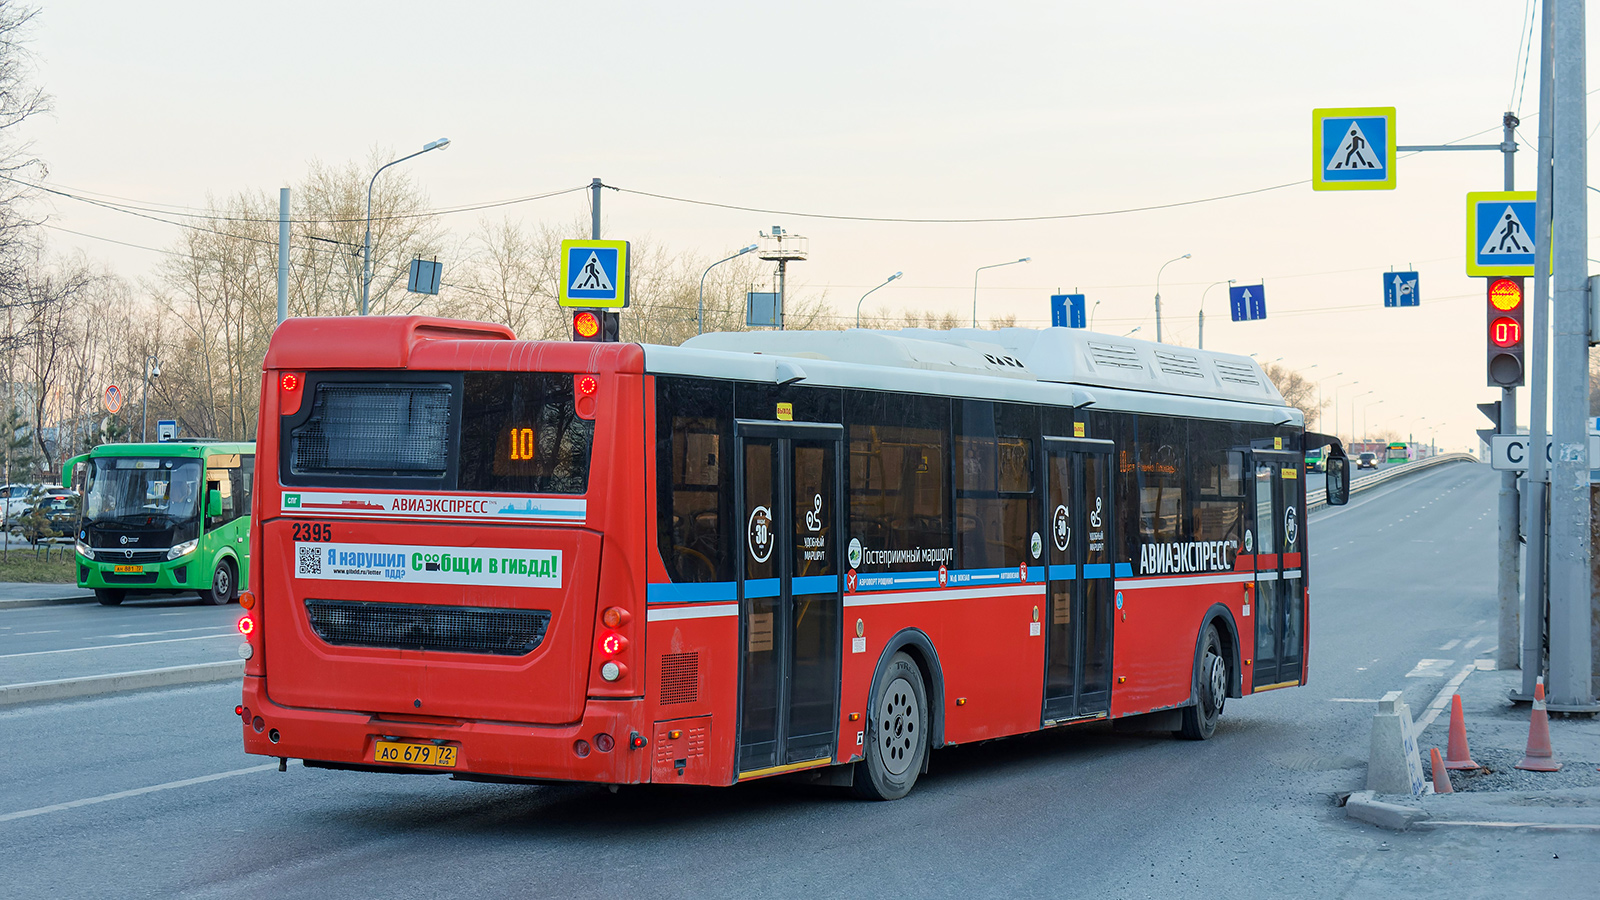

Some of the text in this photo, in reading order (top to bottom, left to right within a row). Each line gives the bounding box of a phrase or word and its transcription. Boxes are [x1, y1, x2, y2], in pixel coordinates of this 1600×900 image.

[1496, 323, 1518, 342] 07
[510, 428, 534, 460] 10
[391, 498, 488, 514] АВИАЭКСПРЕСС
[292, 523, 332, 542] 2395
[755, 524, 768, 545] 30
[803, 535, 825, 548] УДОБНЫЙ
[327, 548, 406, 569] Я нарушил
[804, 550, 826, 561] МАРШРУТ
[862, 546, 954, 569] Гостеприимный маршрут
[1139, 540, 1231, 575] АВИАЭКСПРЕСС
[384, 569, 406, 580] ПДД?
[381, 745, 452, 762] АО 679 72
